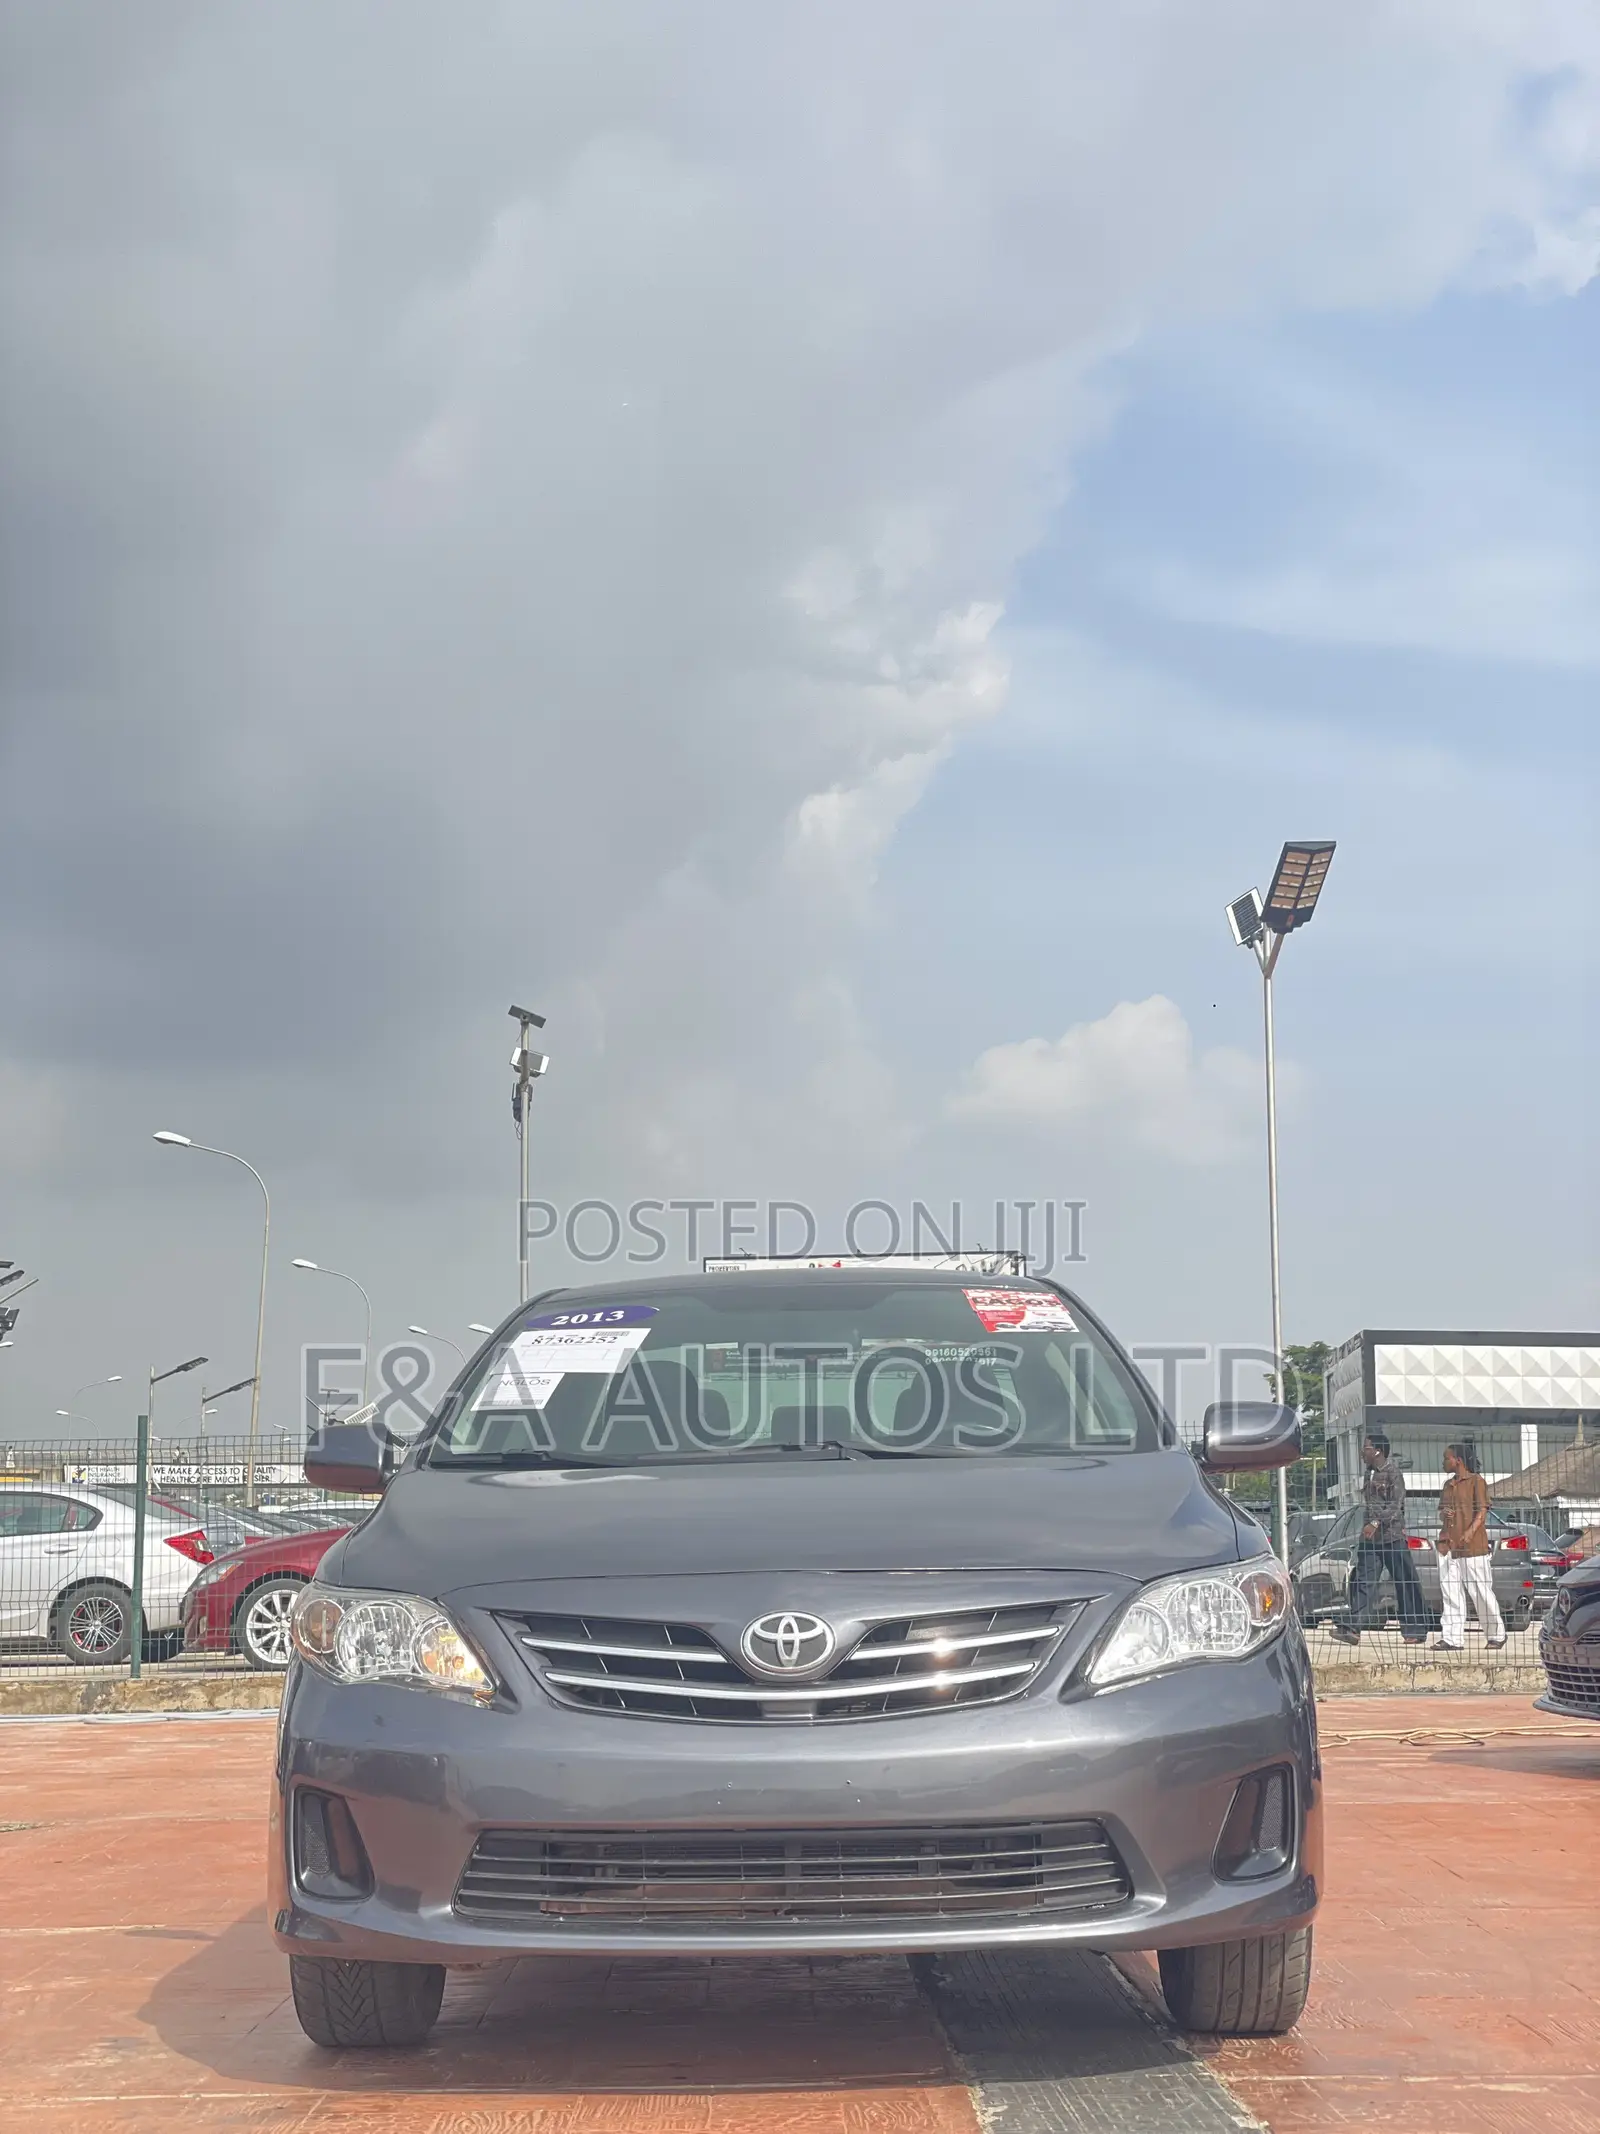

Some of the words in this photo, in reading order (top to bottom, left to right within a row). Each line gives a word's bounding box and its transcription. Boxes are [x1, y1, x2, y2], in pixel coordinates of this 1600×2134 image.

[550, 1310, 625, 1326] 2013
[531, 1336, 618, 1346] 87362252
[153, 1467, 166, 1475] WE
[168, 1467, 192, 1475] MAKE
[194, 1466, 228, 1475] ACCESS
[230, 1467, 240, 1475] TO
[243, 1466, 276, 1474] QALITY
[160, 1475, 212, 1484] HEALTHCARE
[215, 1475, 240, 1483] MUCH
